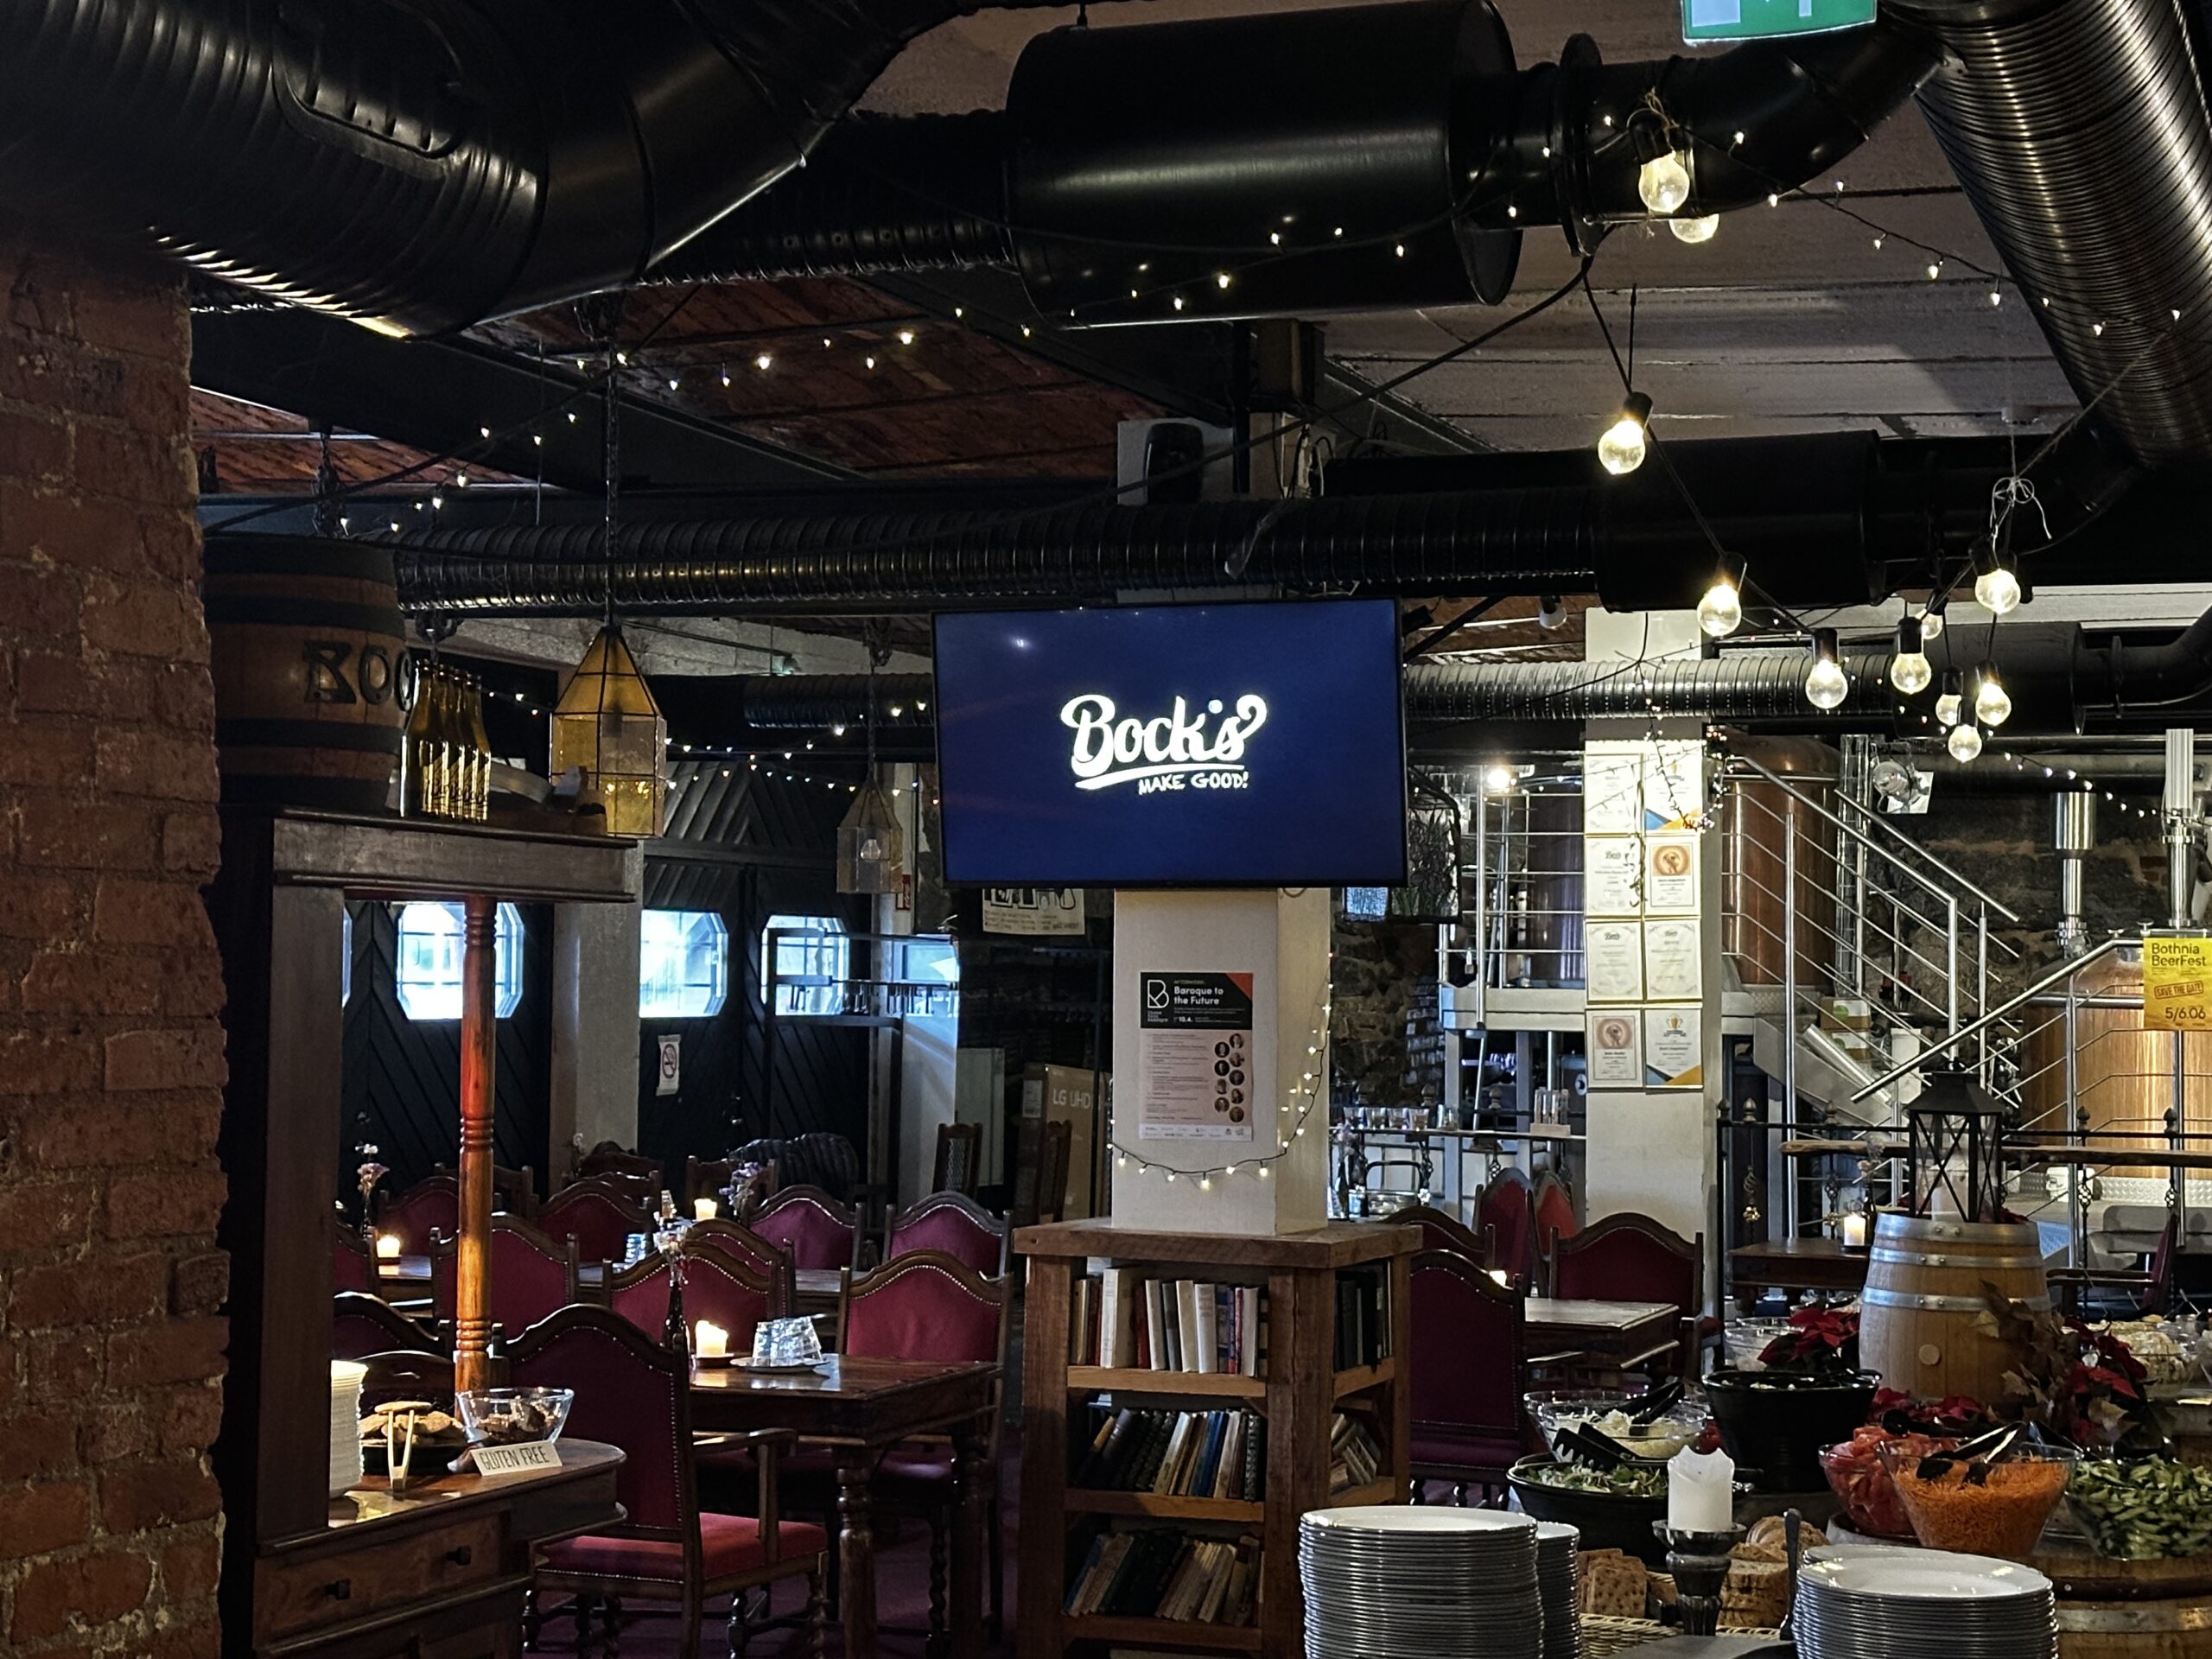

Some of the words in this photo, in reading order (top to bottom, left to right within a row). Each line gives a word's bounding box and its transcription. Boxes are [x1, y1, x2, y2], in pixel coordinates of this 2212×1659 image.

[1061, 694, 1267, 778] Bock's
[1138, 772, 1185, 795] MAKE
[1191, 771, 1249, 790] GOOD!
[2152, 943, 2200, 955] Bothnia
[2152, 955, 2206, 966] BeerFest
[1173, 986, 1212, 995] Baroque
[2156, 986, 2173, 997] SAVE
[2173, 984, 2185, 995] THE
[2186, 982, 2202, 994] DATE
[1173, 996, 1188, 1005] the
[1191, 996, 1219, 1005] Future
[2165, 1007, 2206, 1021] 5/6.06
[1052, 1089, 1066, 1106] LG
[1070, 1090, 1091, 1109] UHD
[478, 1449, 520, 1471] GLUTEN
[519, 1446, 550, 1465] FREE
